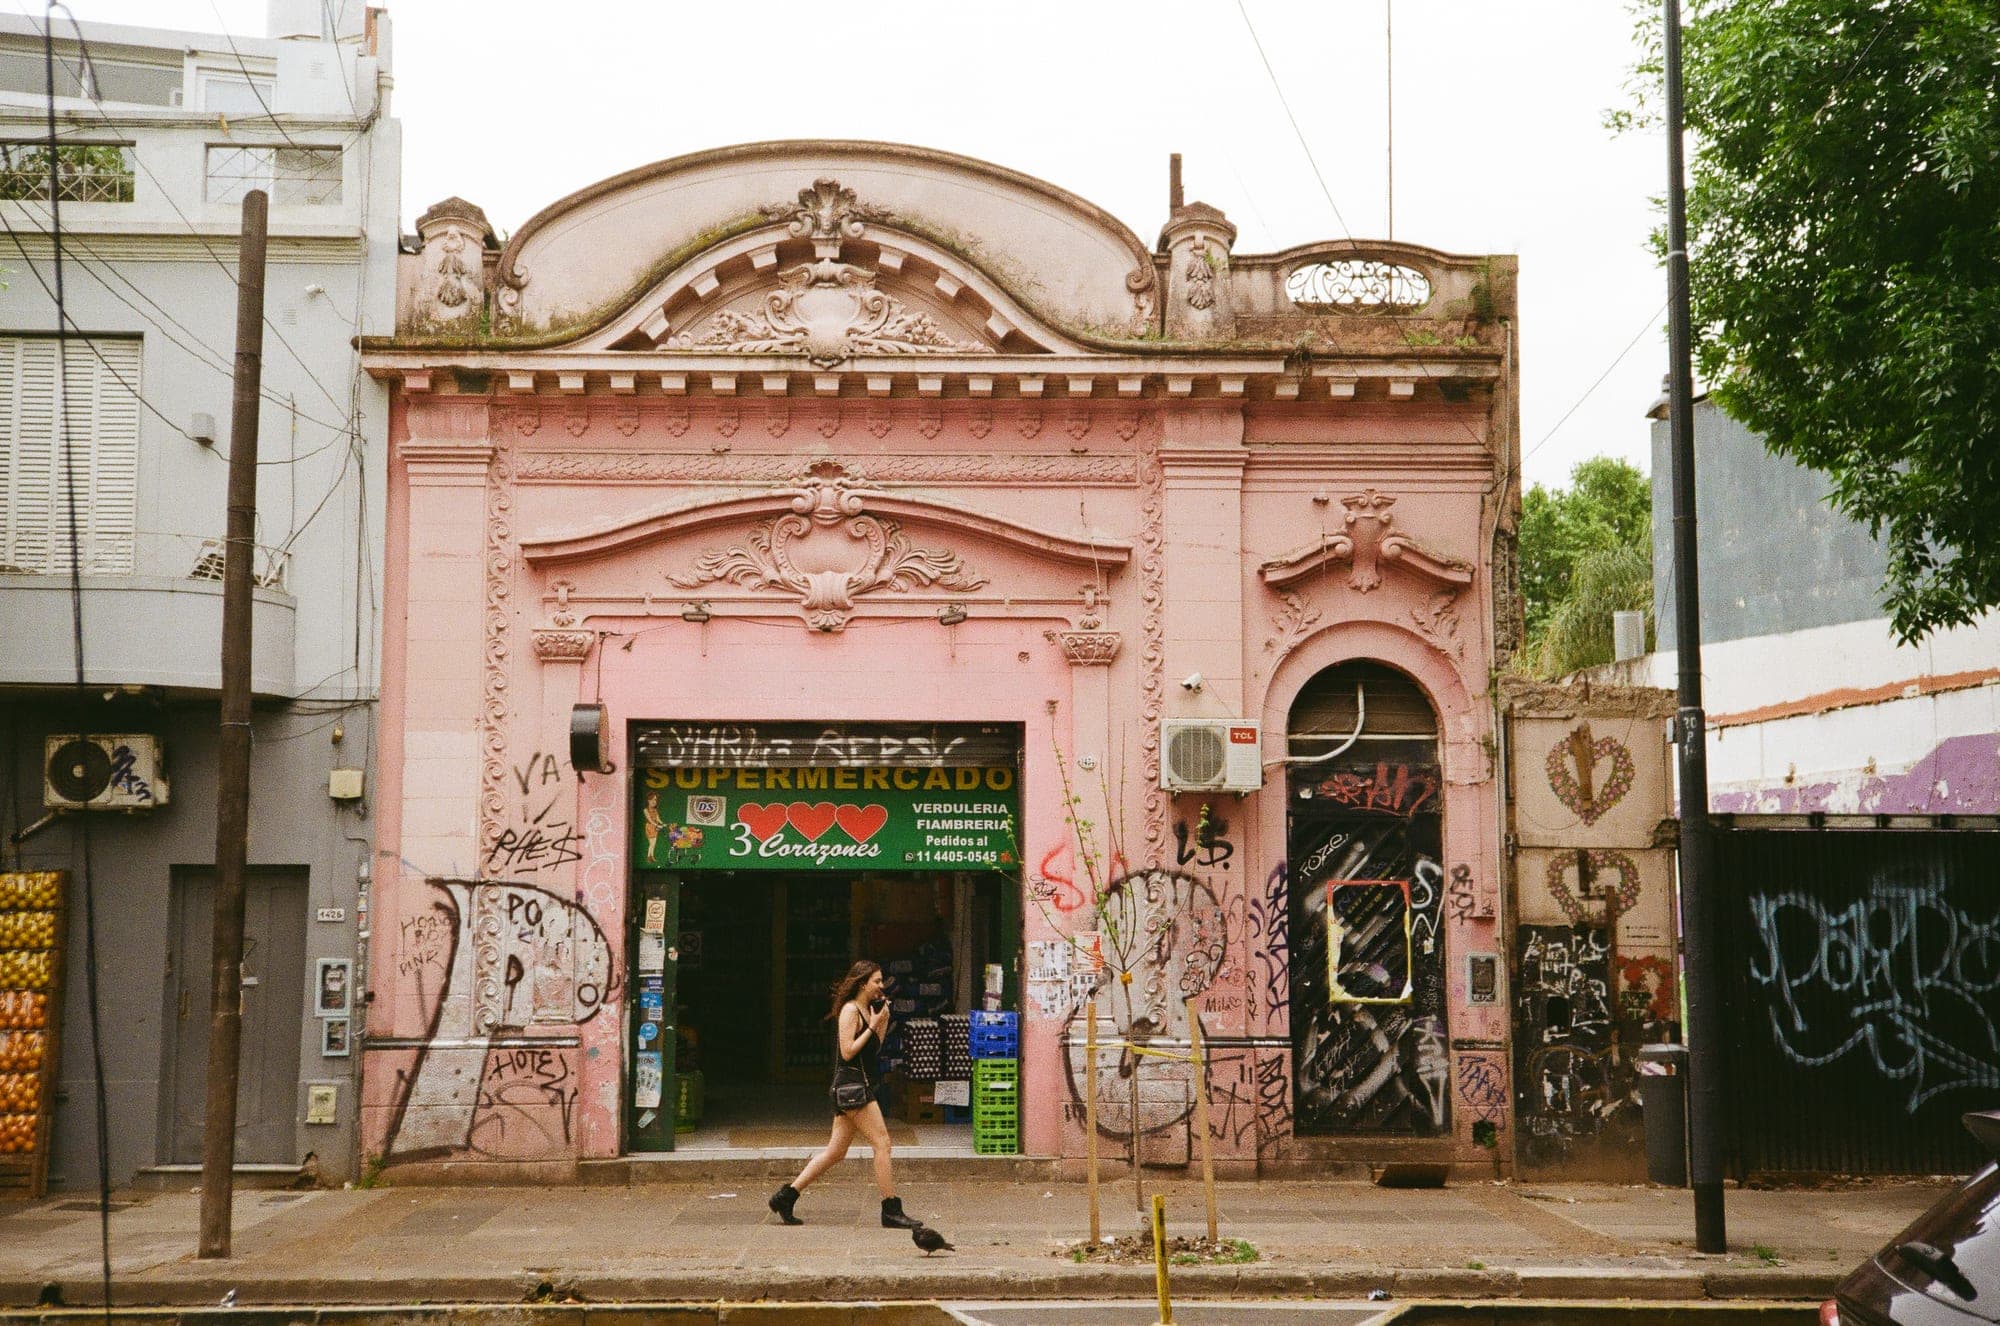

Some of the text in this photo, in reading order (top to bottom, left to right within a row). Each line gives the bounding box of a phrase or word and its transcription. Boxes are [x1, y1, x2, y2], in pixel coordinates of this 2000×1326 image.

[1233, 732, 1254, 740] TCL
[645, 767, 1013, 790] SUPERMERCADO
[697, 802, 715, 812] DS
[912, 803, 1008, 814] VERDULERIA
[917, 819, 1009, 830] FIAMBRERIA
[729, 822, 882, 865] 3 Corazones
[926, 835, 988, 846] Pedidos al
[917, 851, 997, 862] 11 4405-0545
